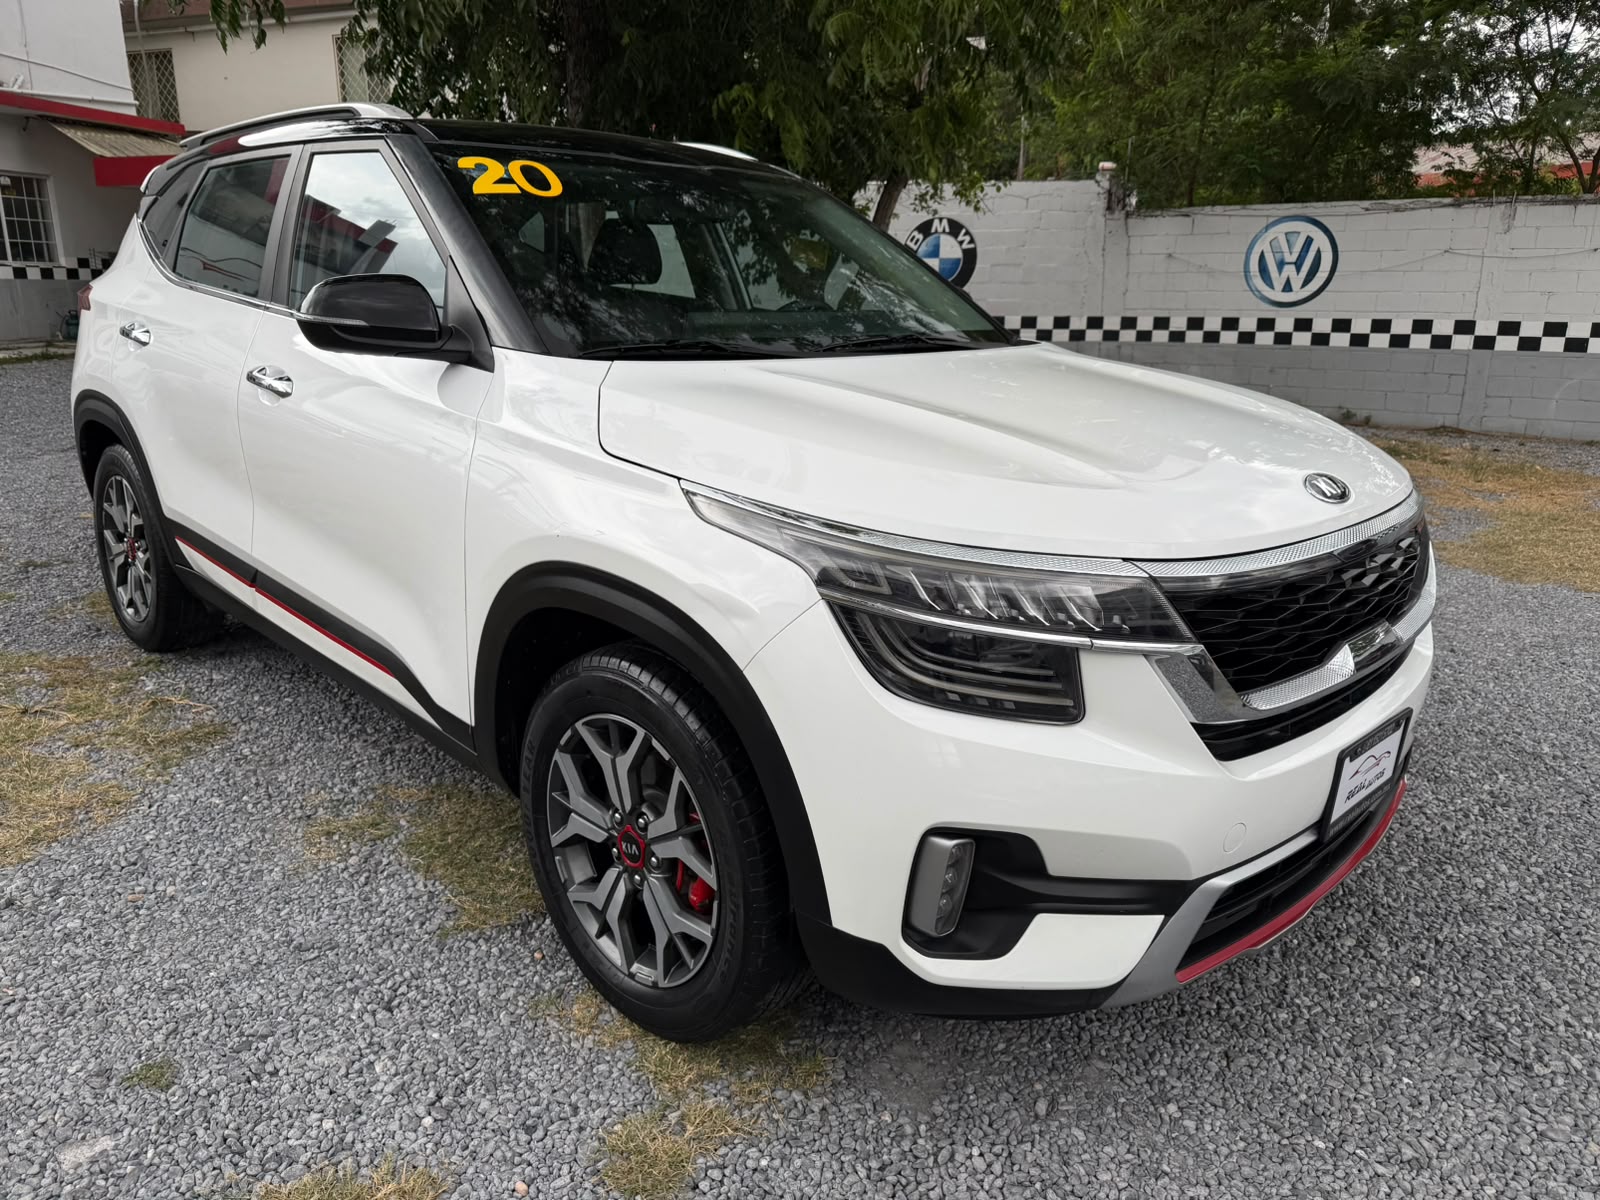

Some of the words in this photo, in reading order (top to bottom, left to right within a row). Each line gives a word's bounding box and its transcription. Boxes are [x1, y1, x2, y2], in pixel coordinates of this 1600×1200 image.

[457, 156, 563, 197] 20
[905, 218, 975, 250] BMW
[1257, 227, 1323, 295] VW
[621, 841, 639, 856] KIA
